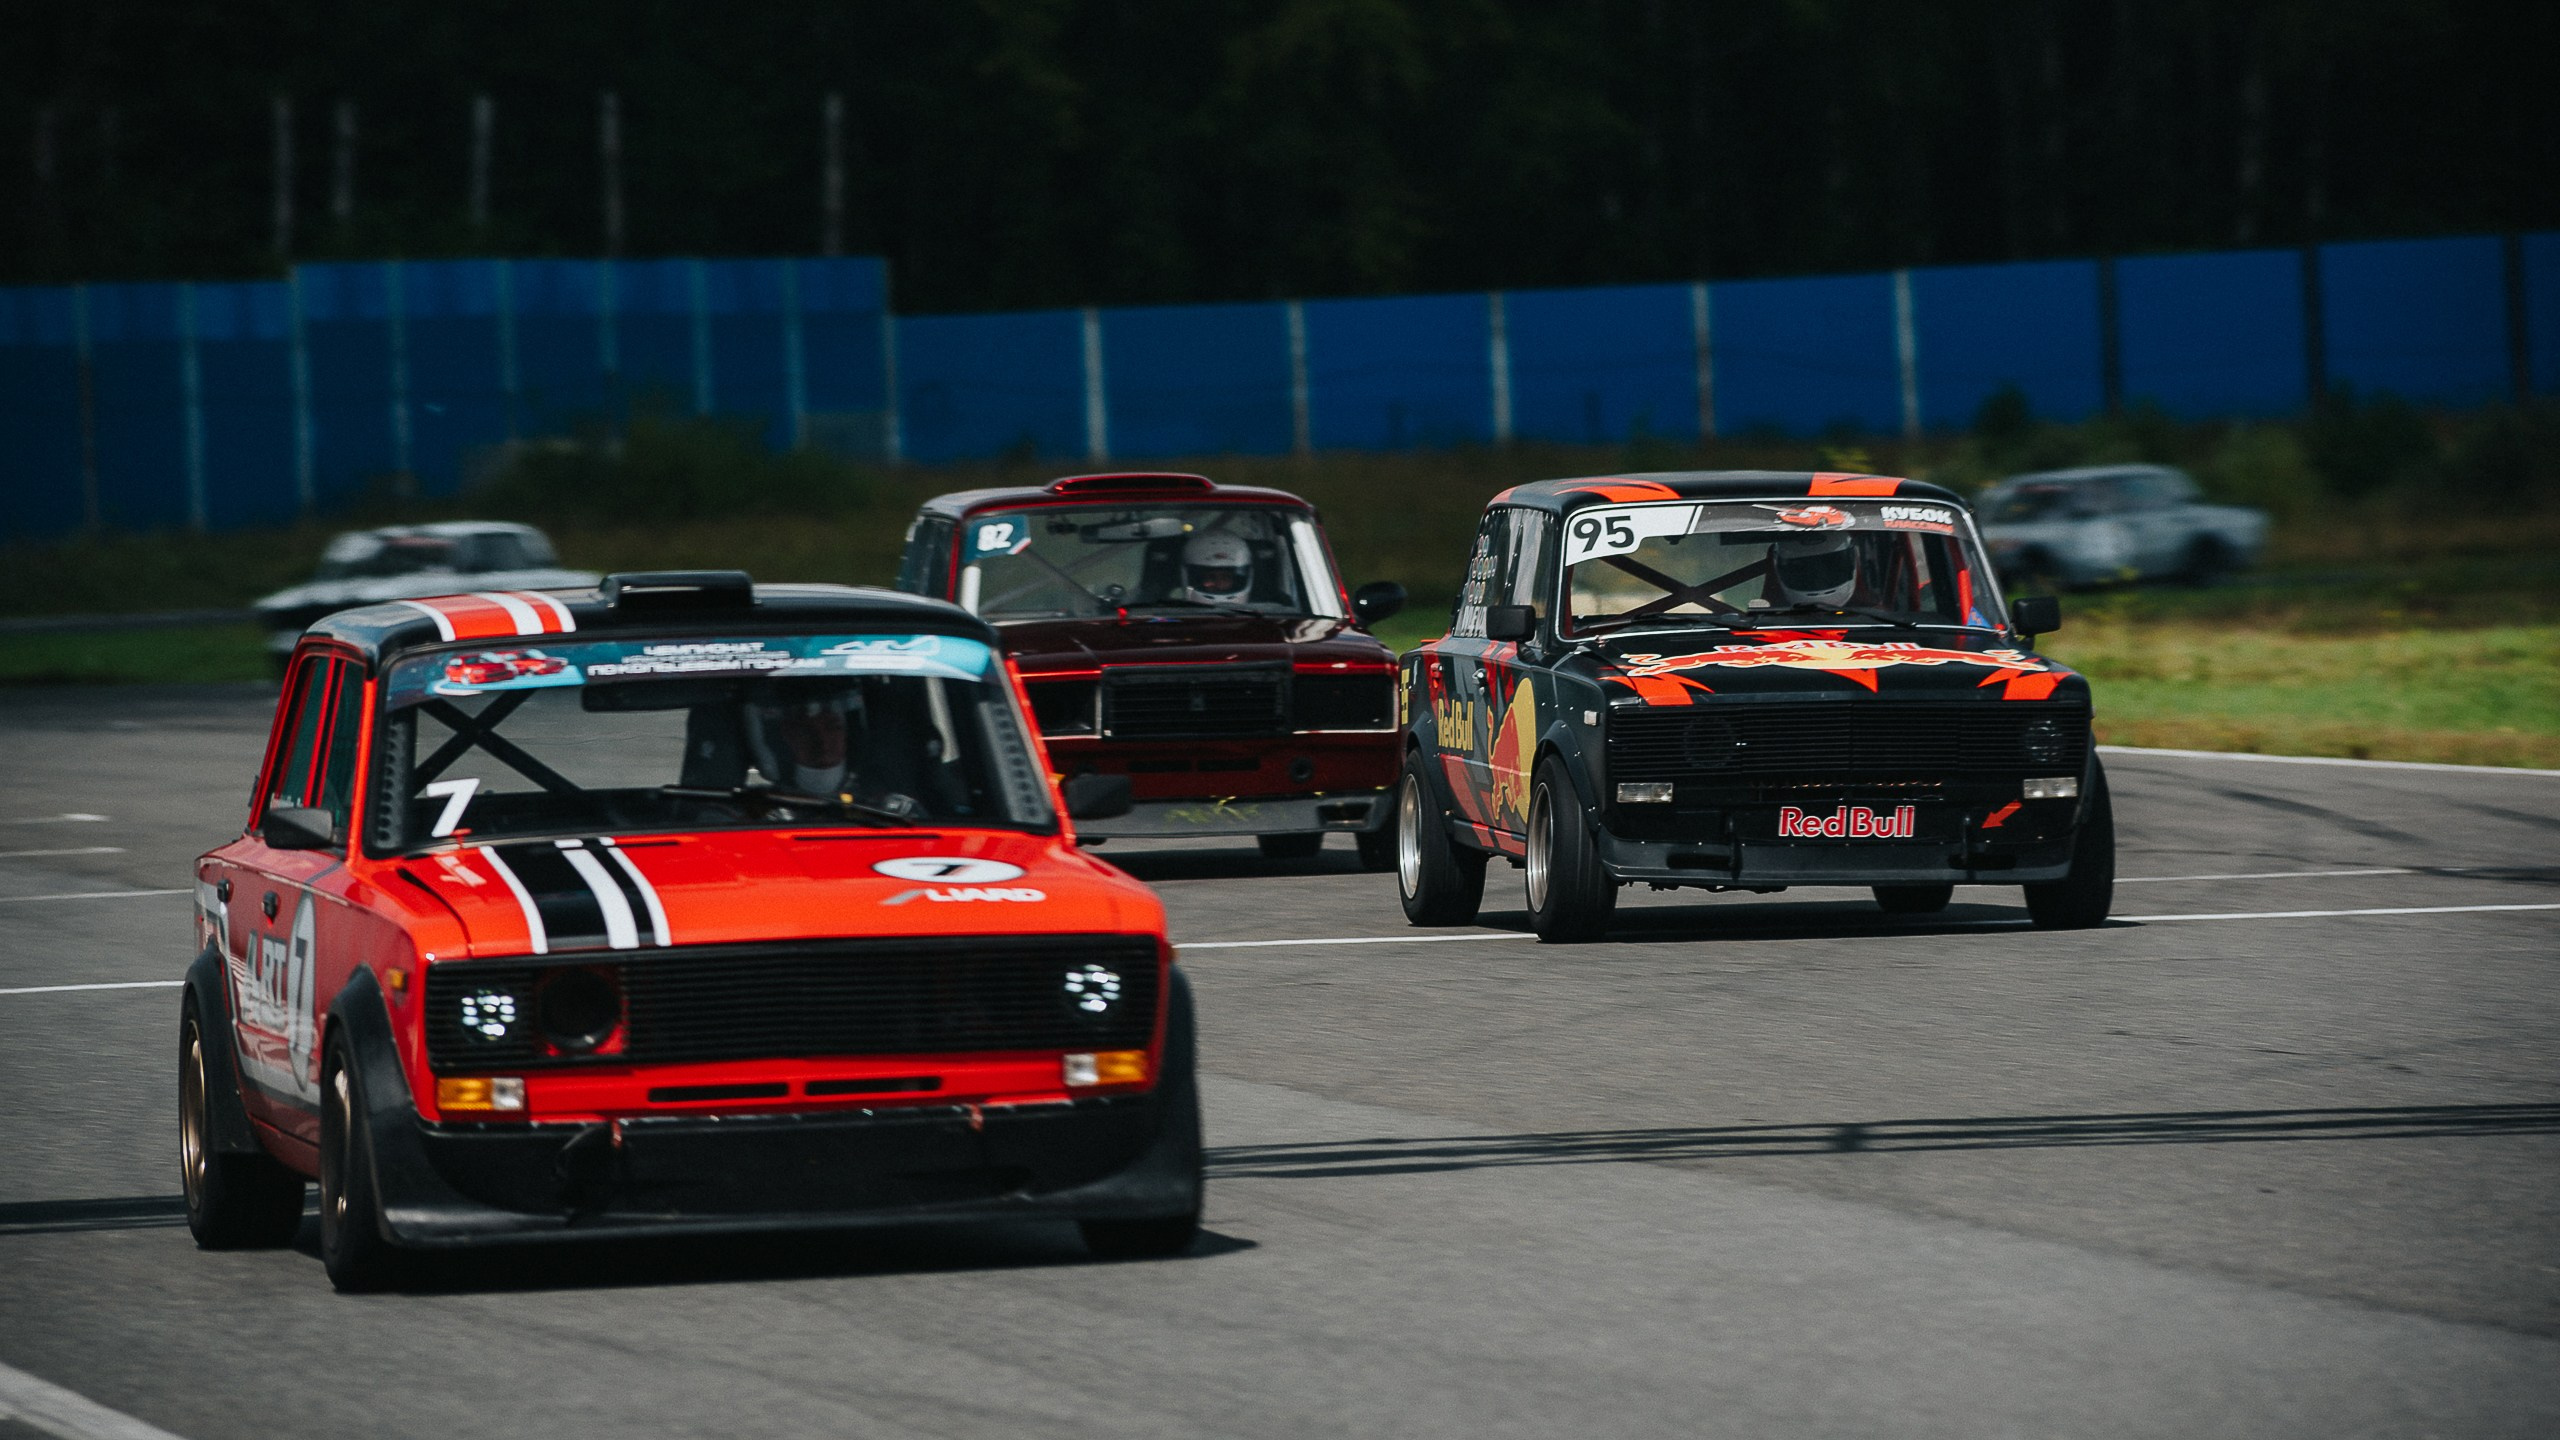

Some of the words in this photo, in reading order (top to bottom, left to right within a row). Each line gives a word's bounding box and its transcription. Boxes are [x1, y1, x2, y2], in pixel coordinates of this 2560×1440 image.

[1880, 506, 1953, 525] КУБОК
[977, 523, 1014, 551] 82
[1573, 515, 1635, 554] 95
[1713, 641, 1814, 654] Red
[1822, 640, 1922, 652] Bull
[1438, 698, 1455, 748] Red
[1456, 701, 1474, 751] Bull
[426, 778, 480, 838] 7
[1778, 806, 1847, 838] Red
[1849, 805, 1915, 838] Bull
[910, 861, 974, 877] 7
